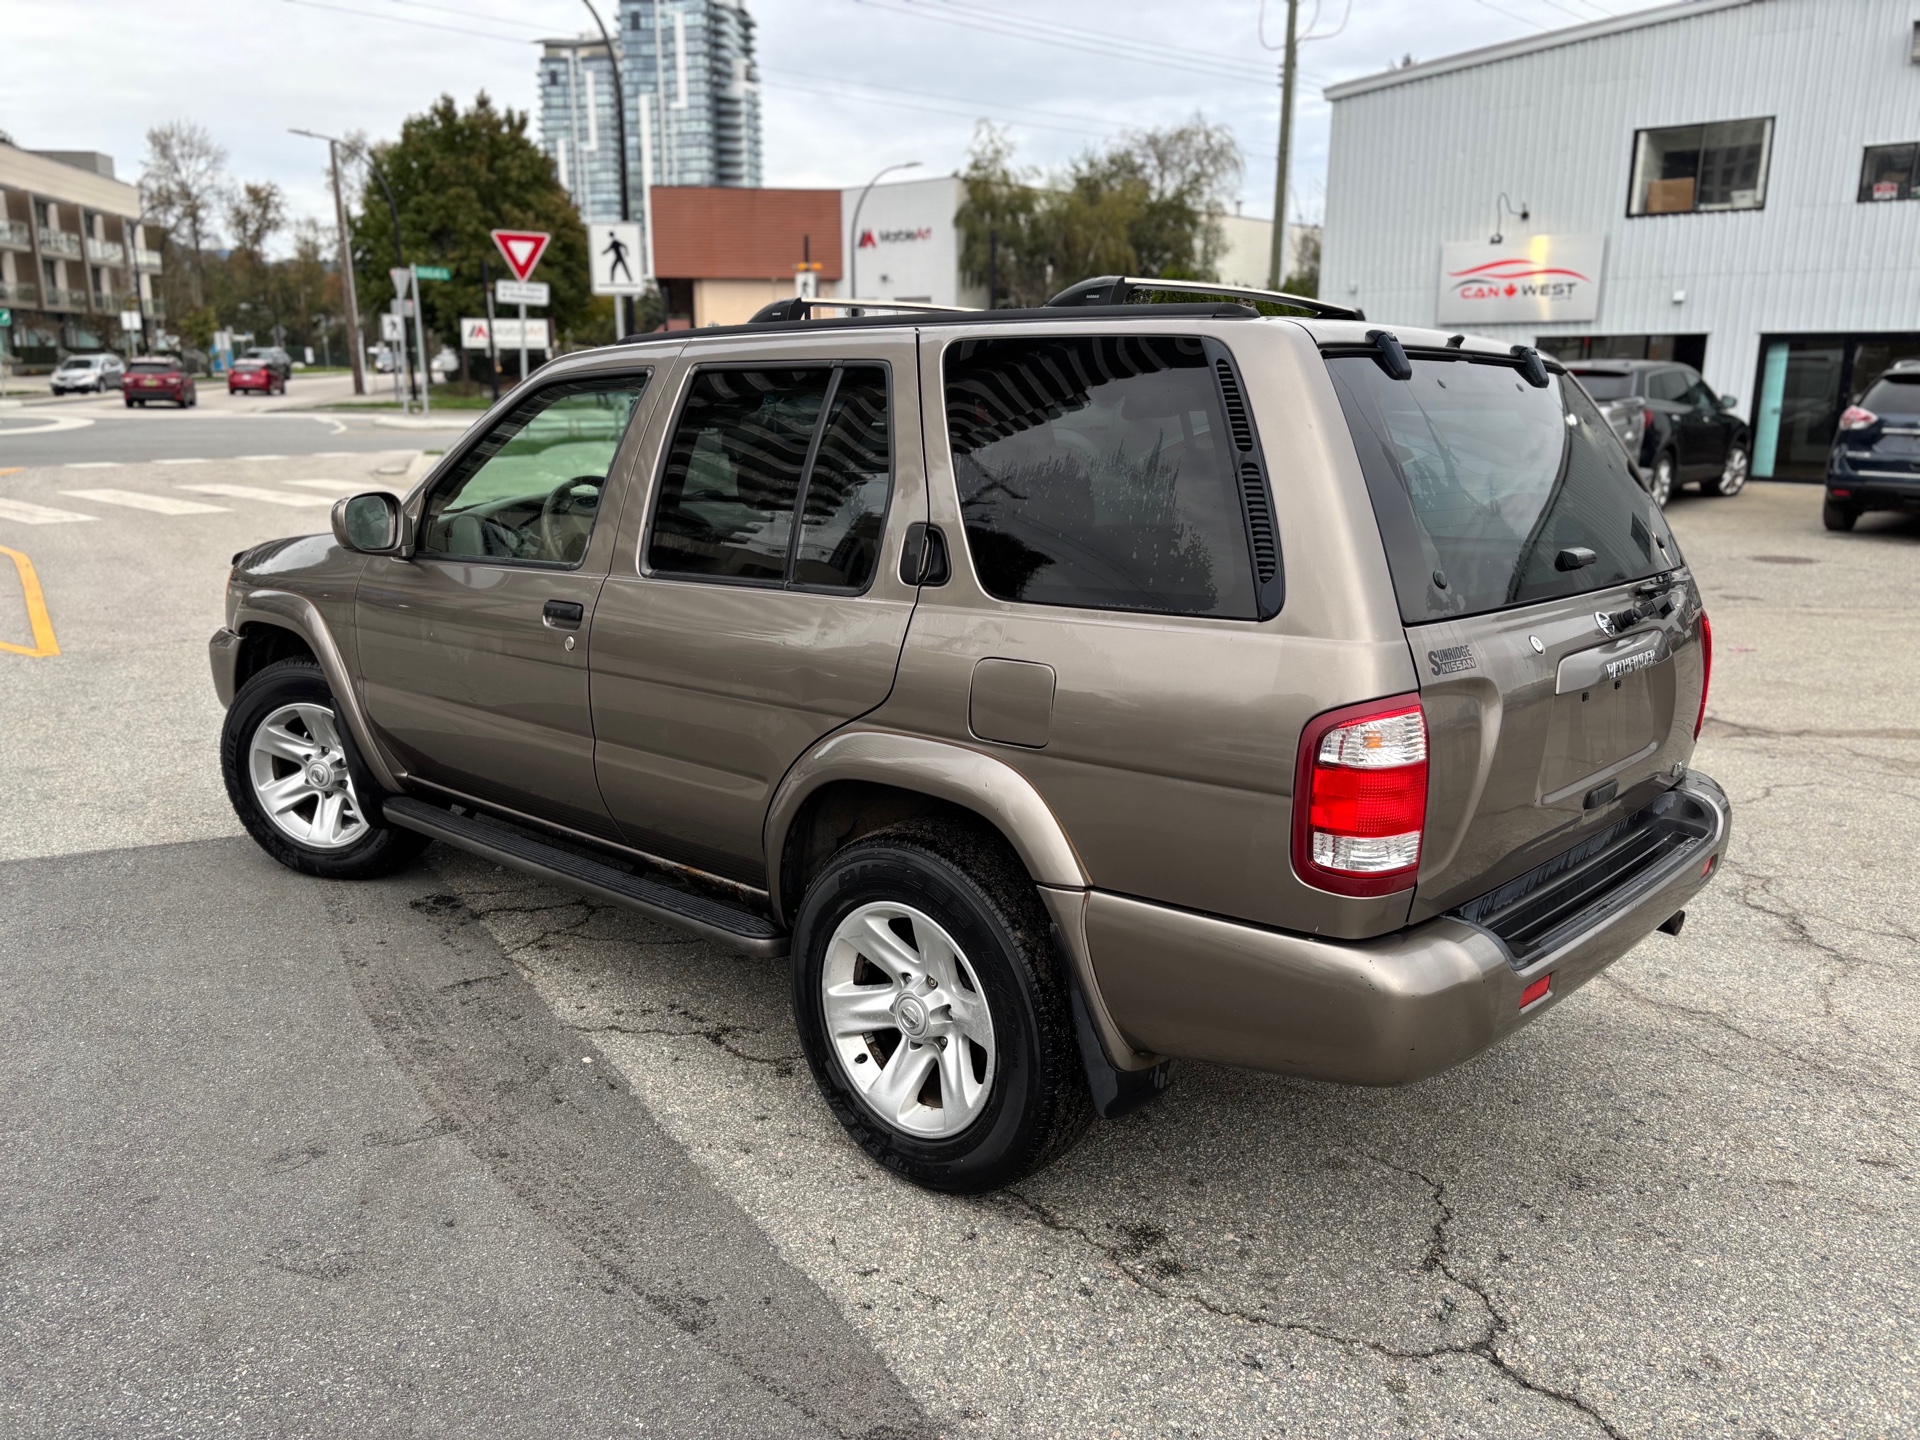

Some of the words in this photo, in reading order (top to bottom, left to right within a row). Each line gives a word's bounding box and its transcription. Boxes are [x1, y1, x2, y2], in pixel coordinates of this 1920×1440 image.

[1460, 286, 1500, 300] CAN
[1521, 282, 1577, 297] WEST
[1428, 645, 1472, 676] SUNRIDGE
[1441, 658, 1476, 674] NISSAN
[838, 863, 975, 929] DUELER
